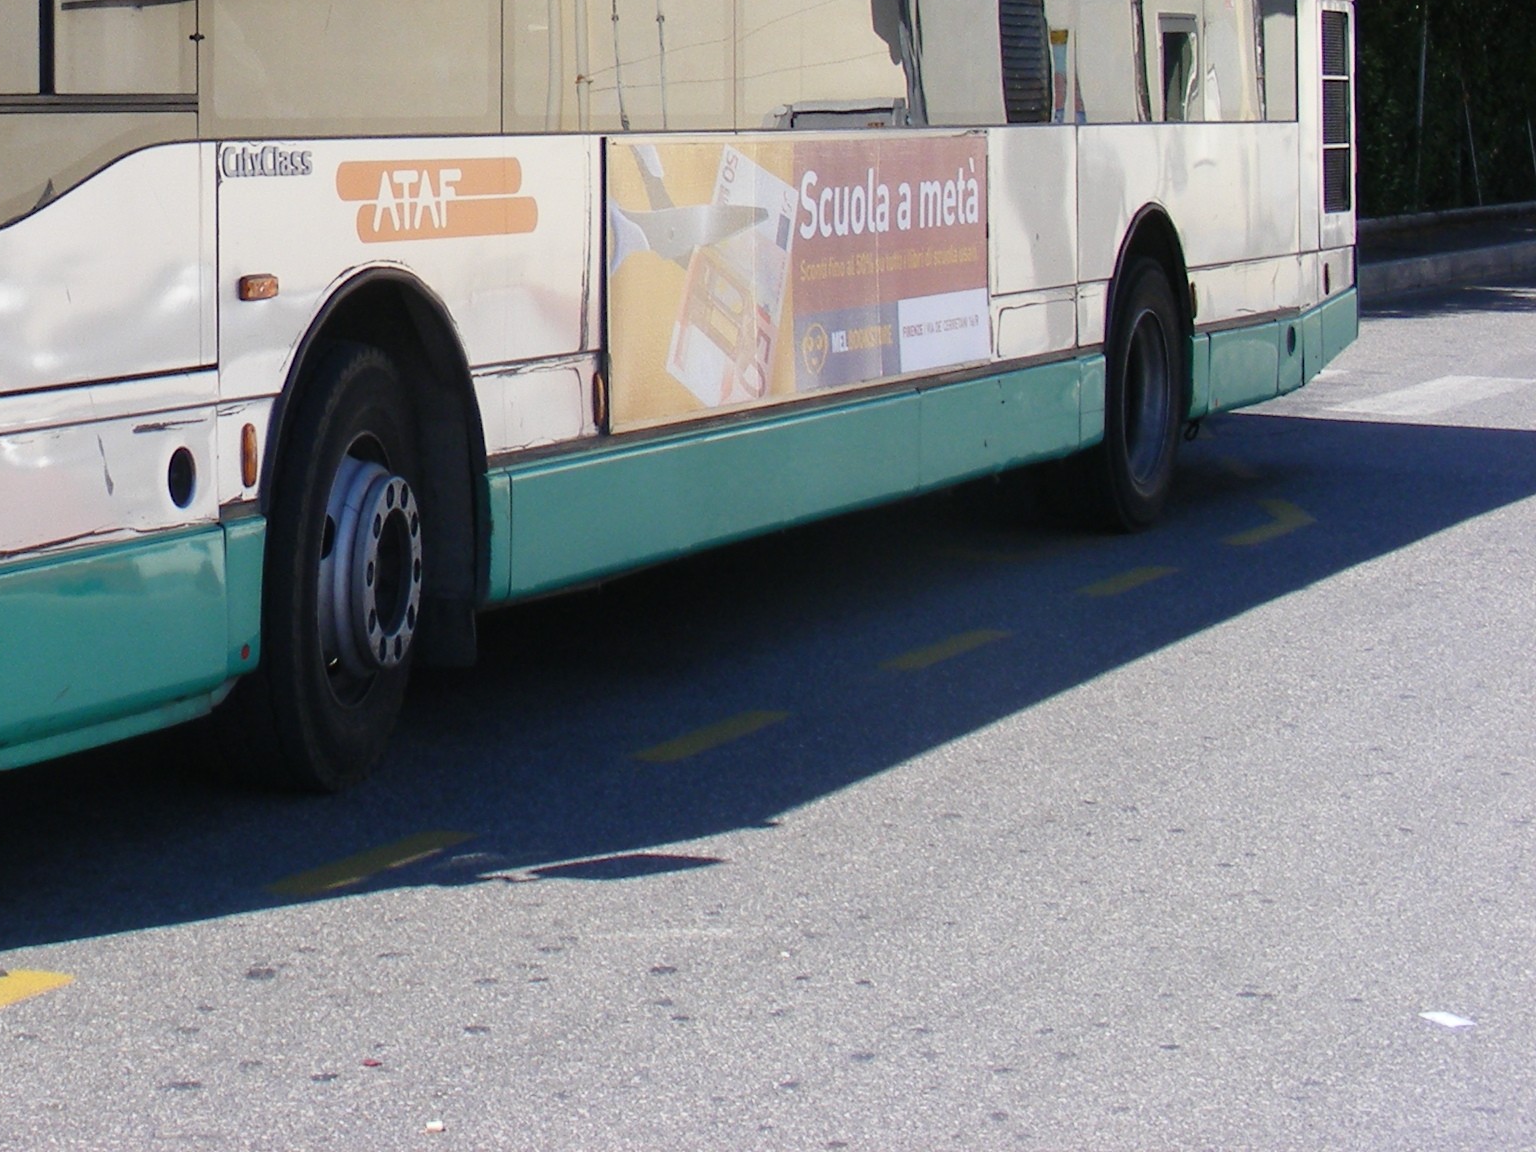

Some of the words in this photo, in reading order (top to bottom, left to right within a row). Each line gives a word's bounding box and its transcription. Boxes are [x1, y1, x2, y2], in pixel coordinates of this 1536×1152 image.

[221, 145, 313, 178] CityClass
[372, 167, 463, 233] ATAF
[799, 167, 890, 240] Scuola
[896, 182, 912, 231] a
[919, 157, 979, 229] metà
